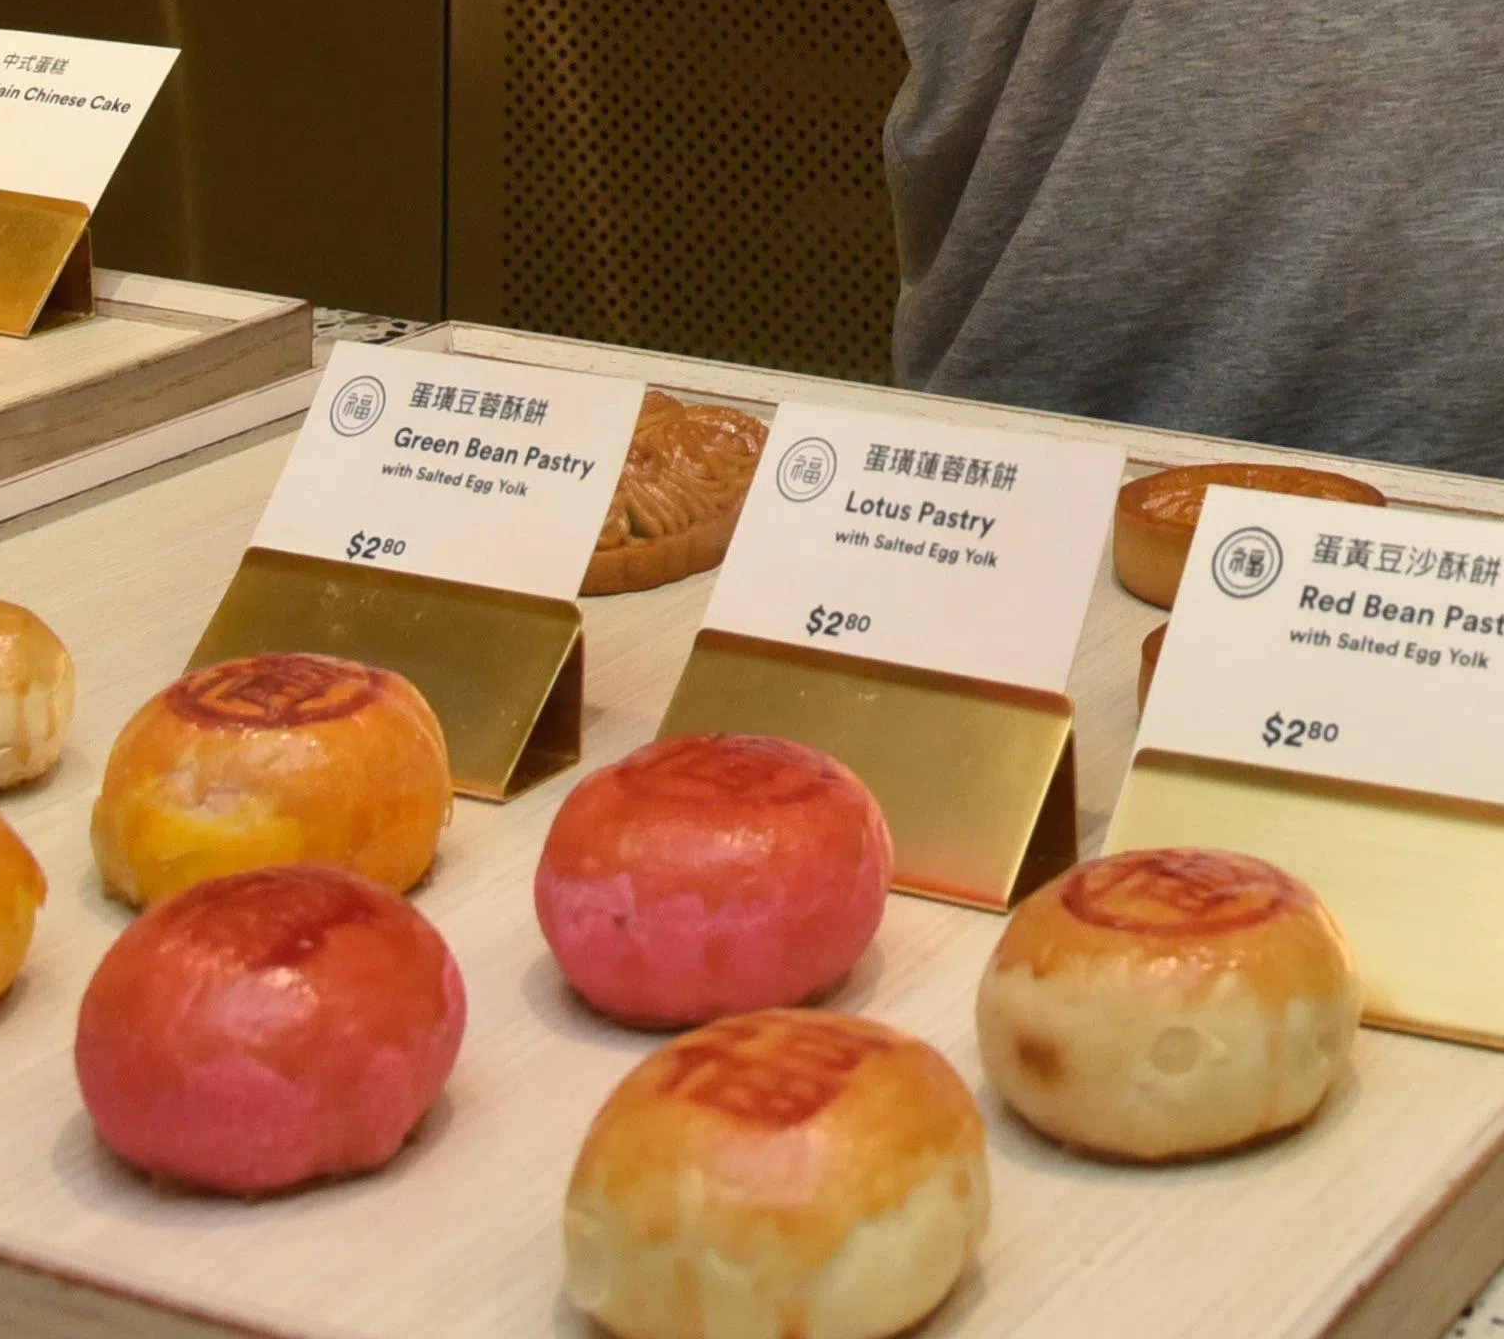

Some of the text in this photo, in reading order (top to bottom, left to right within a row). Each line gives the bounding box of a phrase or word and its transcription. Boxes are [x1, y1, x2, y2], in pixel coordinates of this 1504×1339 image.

[2, 52, 70, 76] 中式蛋糕
[23, 86, 87, 108] Chinese
[89, 95, 132, 114] Cake
[408, 381, 549, 426] 蛋璜豆蓉酥餅
[394, 426, 596, 481] Green Bean Pastry
[863, 443, 1019, 492] 蛋璜蓮蓉酥餅
[381, 462, 528, 497] with Salted Egg Yolk
[844, 490, 996, 539] Lotus Pastry
[835, 529, 998, 568] with Salted Egg Yolk
[1311, 533, 1502, 587] 蛋黃豆沙酥餅
[1299, 584, 1356, 616] Red
[1362, 593, 1435, 627] Bean
[1289, 628, 1489, 670] with Salted Egg Yolk
